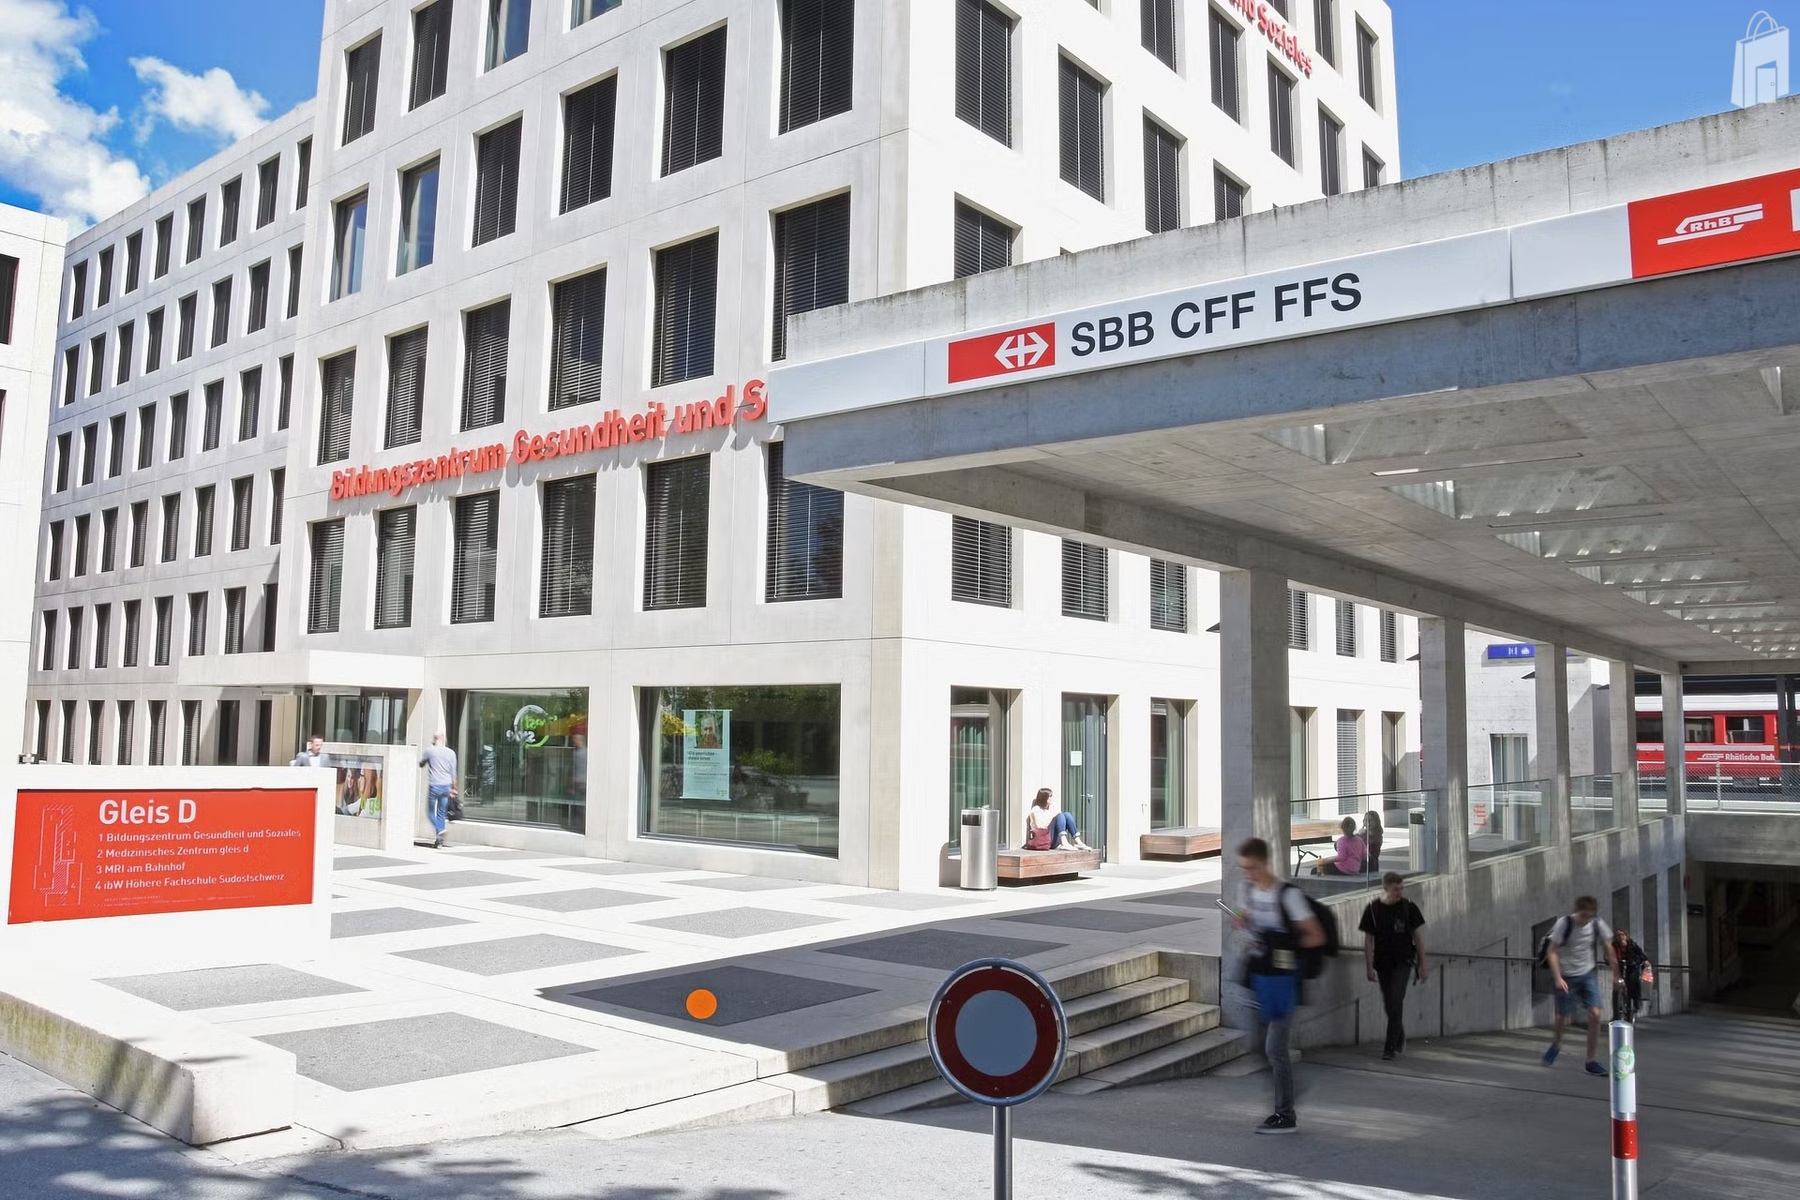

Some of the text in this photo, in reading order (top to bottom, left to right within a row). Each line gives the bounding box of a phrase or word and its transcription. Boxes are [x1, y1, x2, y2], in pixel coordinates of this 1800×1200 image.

[1690, 217, 1732, 232] RhB
[1071, 272, 1362, 357] SBB CFF FFS
[331, 379, 768, 500] Bildungszentrum Gesundheit und S
[1725, 753, 1760, 761] Rhätische
[1761, 753, 1775, 761] Bah
[99, 799, 197, 824] Gleis D
[98, 829, 301, 843] 1 Bildungszentrum Gesundheit und Soziales
[97, 844, 249, 858] 2 Medizinisches Zentrum gleis d
[96, 862, 186, 874] 3 MRI am Bahnhof
[95, 873, 285, 889] 4 ibW Höhere Fachschule Südostschweiz
